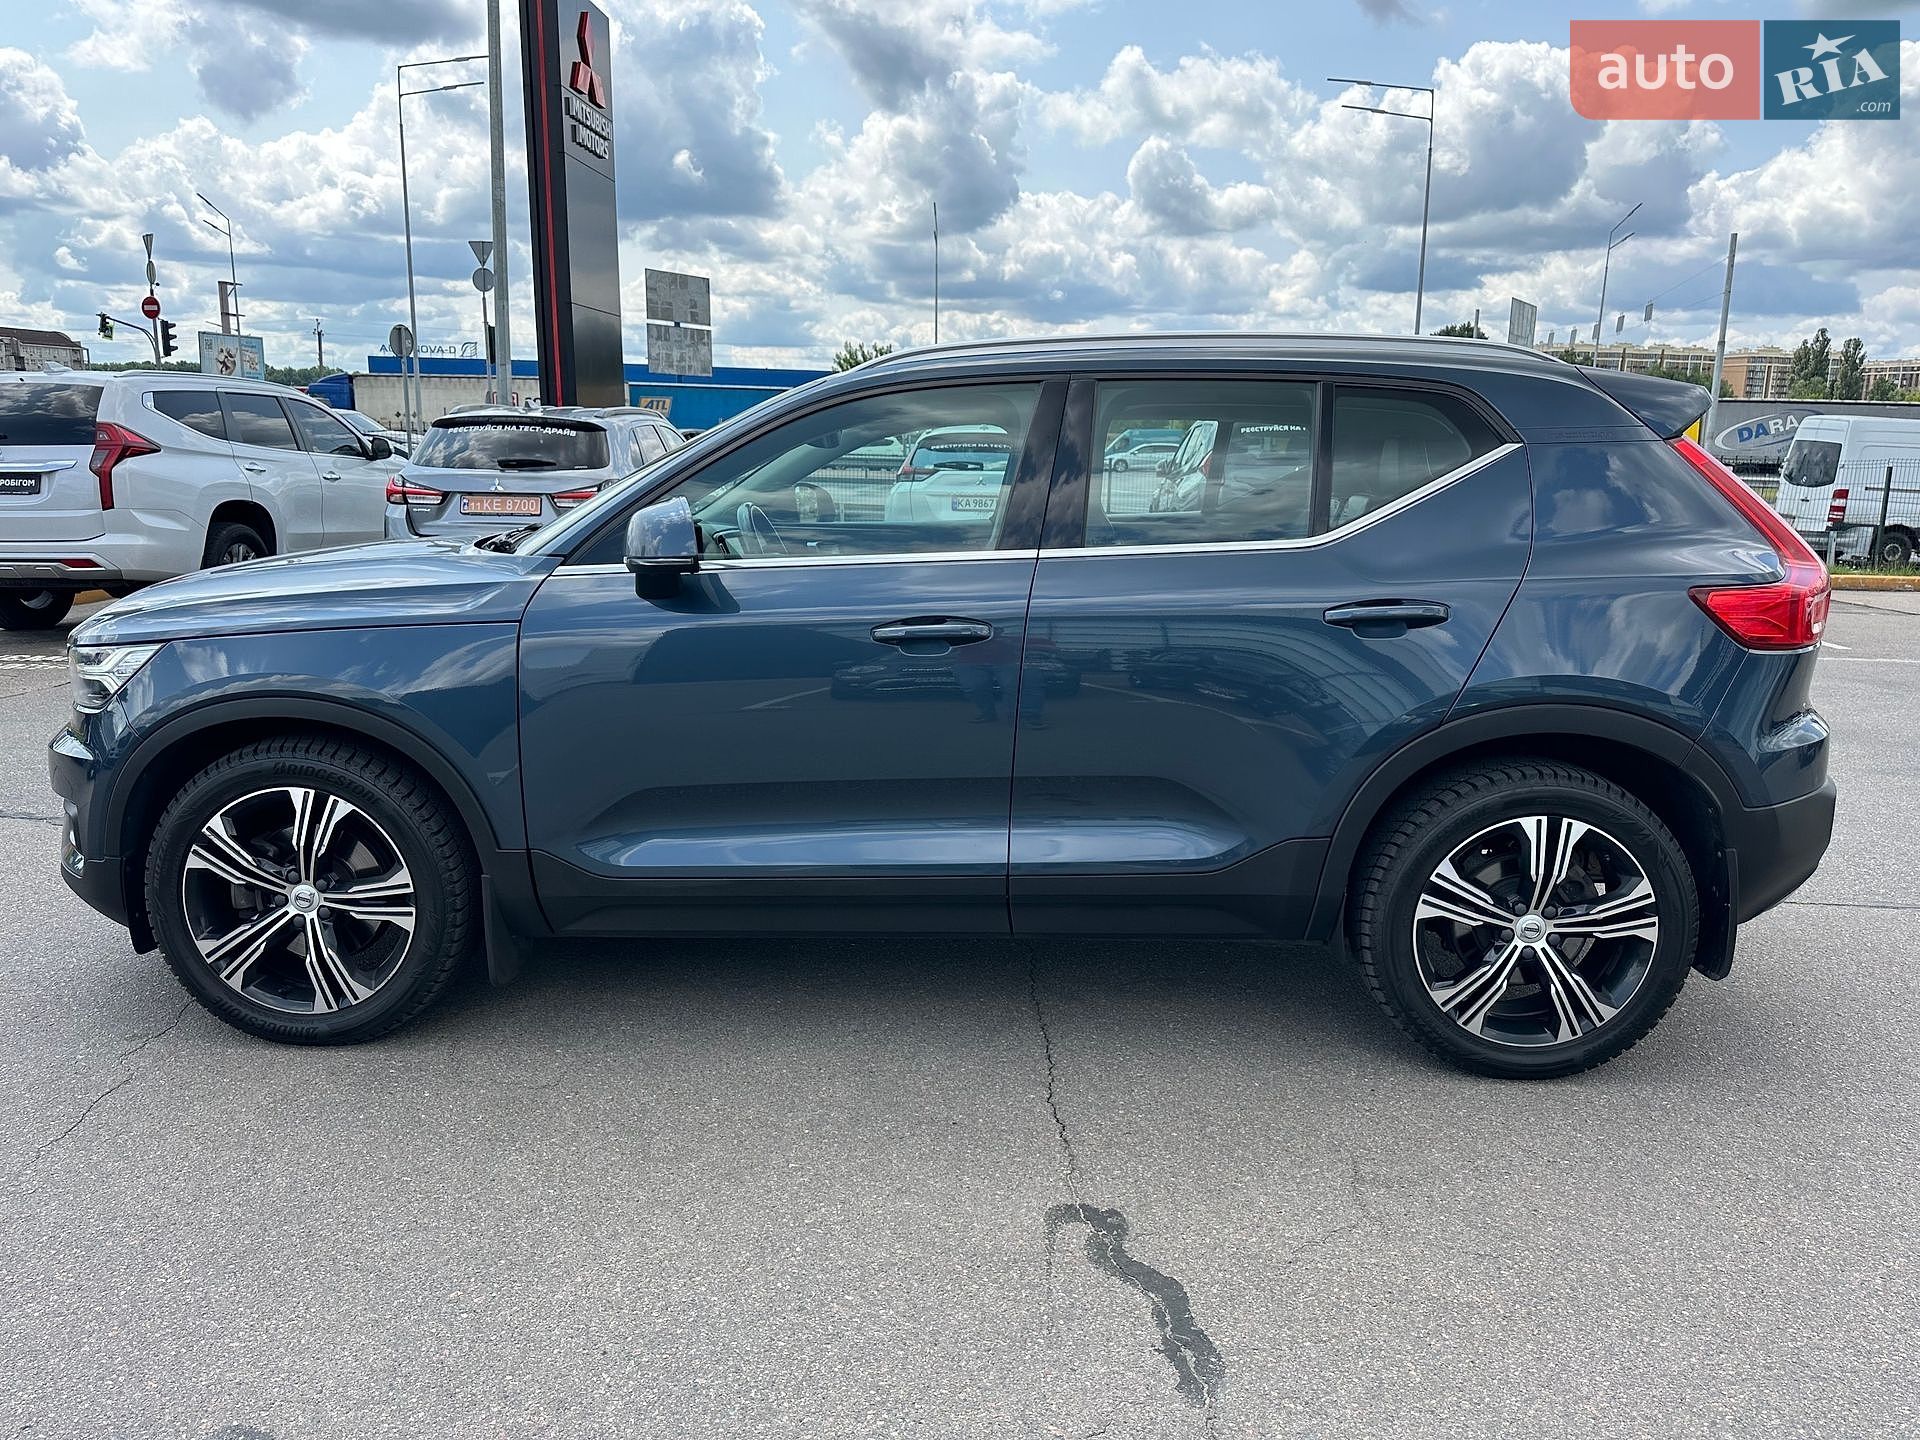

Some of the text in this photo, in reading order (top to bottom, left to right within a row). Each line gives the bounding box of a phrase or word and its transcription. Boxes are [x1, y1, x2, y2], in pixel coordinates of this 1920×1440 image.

[568, 97, 612, 141] MITSUBISHI
[574, 124, 609, 160] MOTORS
[519, 425, 577, 437] ТЕСТ-ДРАЙВ
[483, 500, 502, 511] KE
[506, 500, 536, 511] 8700
[957, 499, 995, 508] KA 9867
